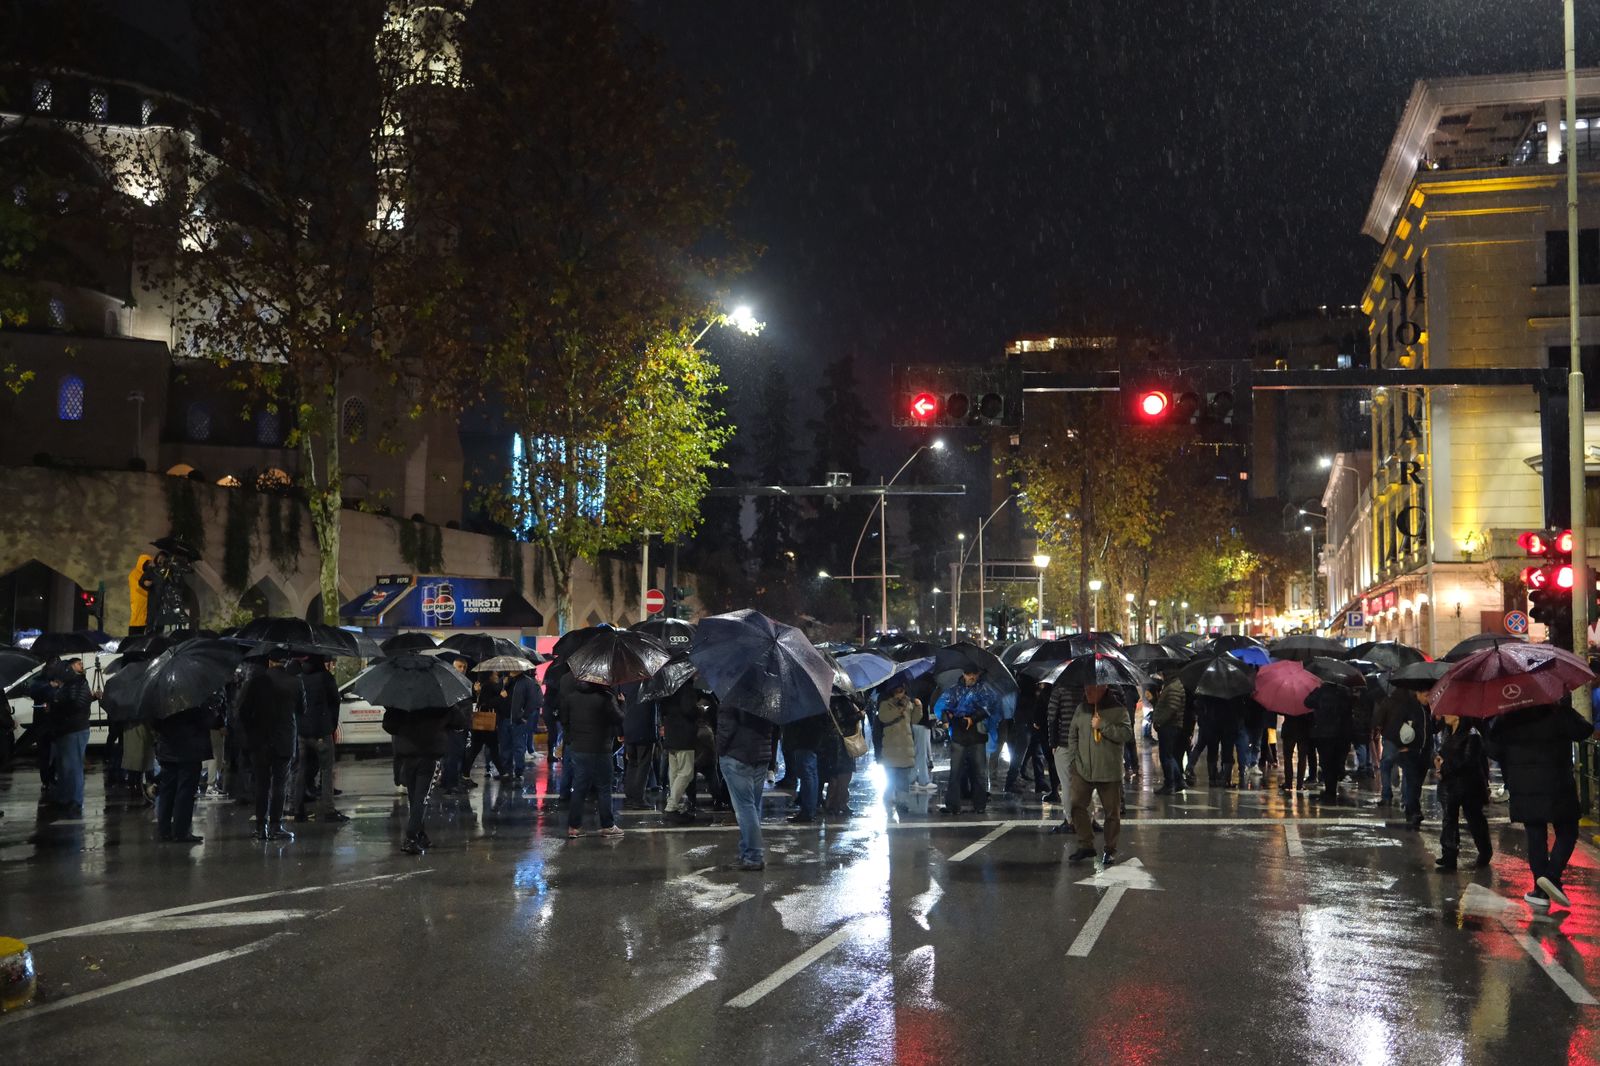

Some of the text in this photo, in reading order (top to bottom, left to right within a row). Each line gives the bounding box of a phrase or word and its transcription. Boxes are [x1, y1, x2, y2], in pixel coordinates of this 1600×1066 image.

[1390, 271, 1426, 538] MOARC
[461, 599, 503, 607] THIRSTY
[1351, 613, 1362, 626] P
